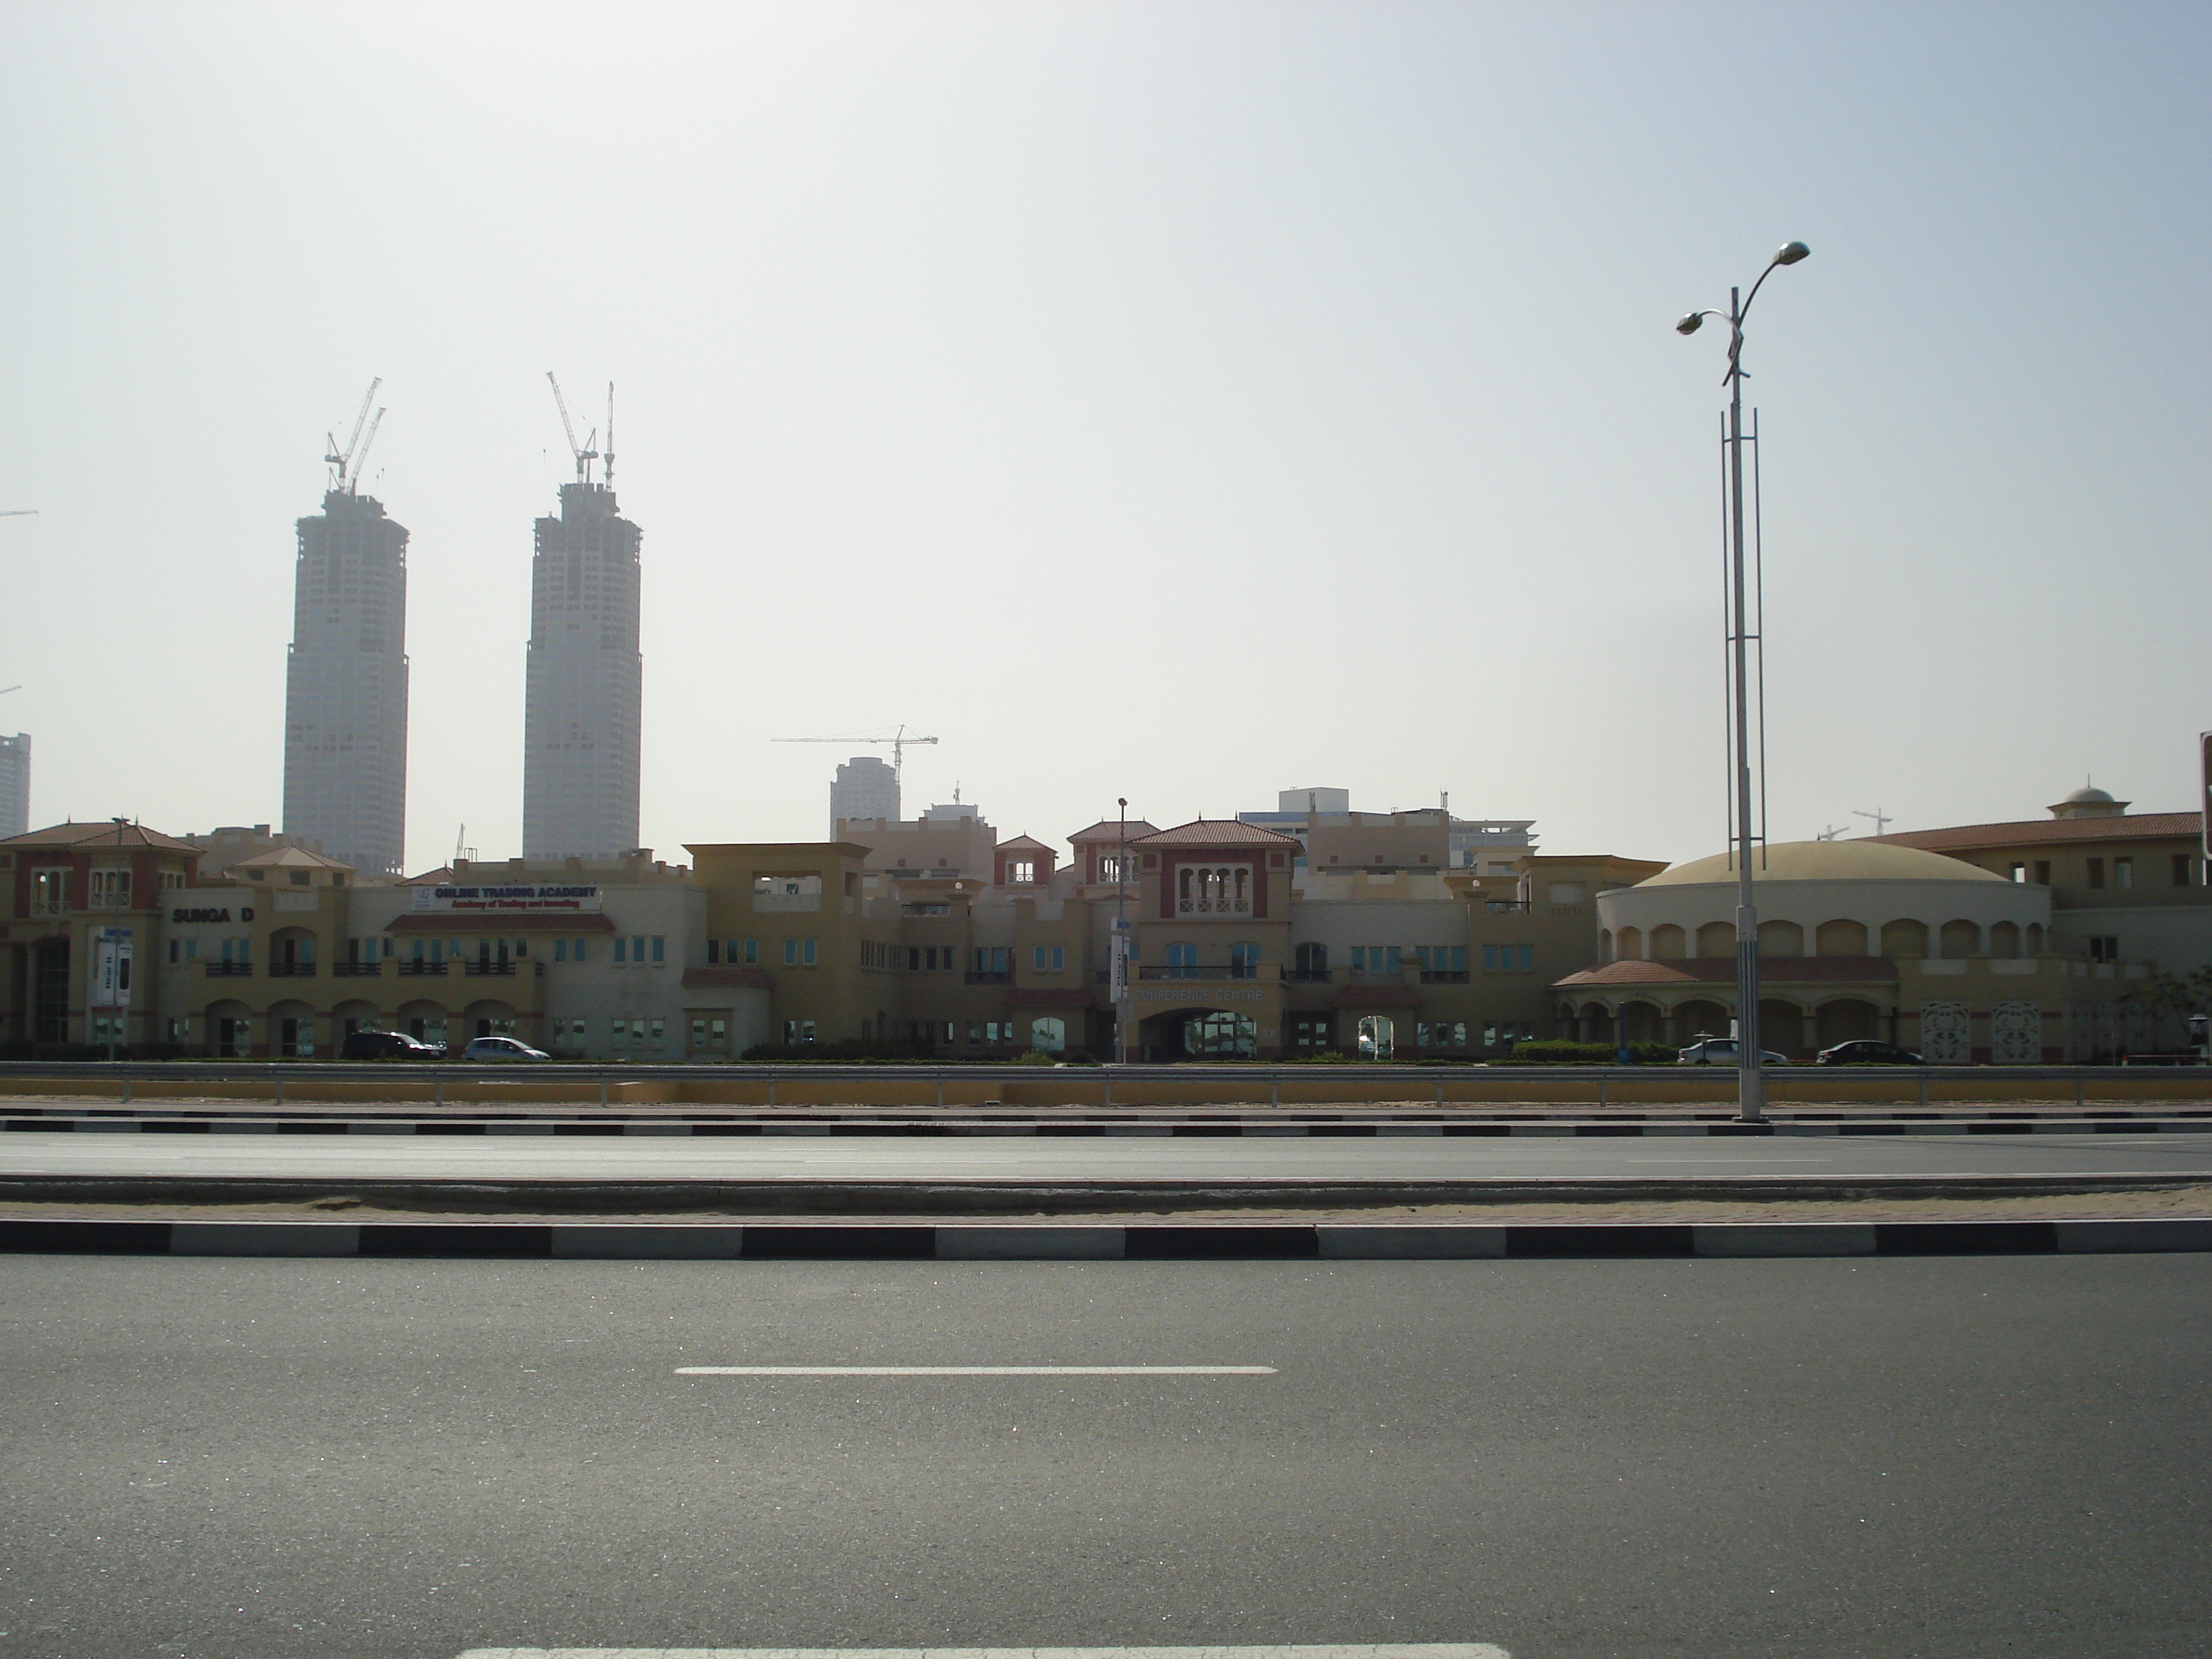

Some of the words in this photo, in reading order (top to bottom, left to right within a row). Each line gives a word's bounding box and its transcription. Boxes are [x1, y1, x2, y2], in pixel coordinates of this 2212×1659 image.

[436, 888, 479, 898] ONLINE
[482, 887, 535, 898] TRADING
[538, 887, 597, 897] ACADEMY
[1133, 990, 1211, 1002] CONFERENCE
[1216, 990, 1263, 1002] CENTRE
